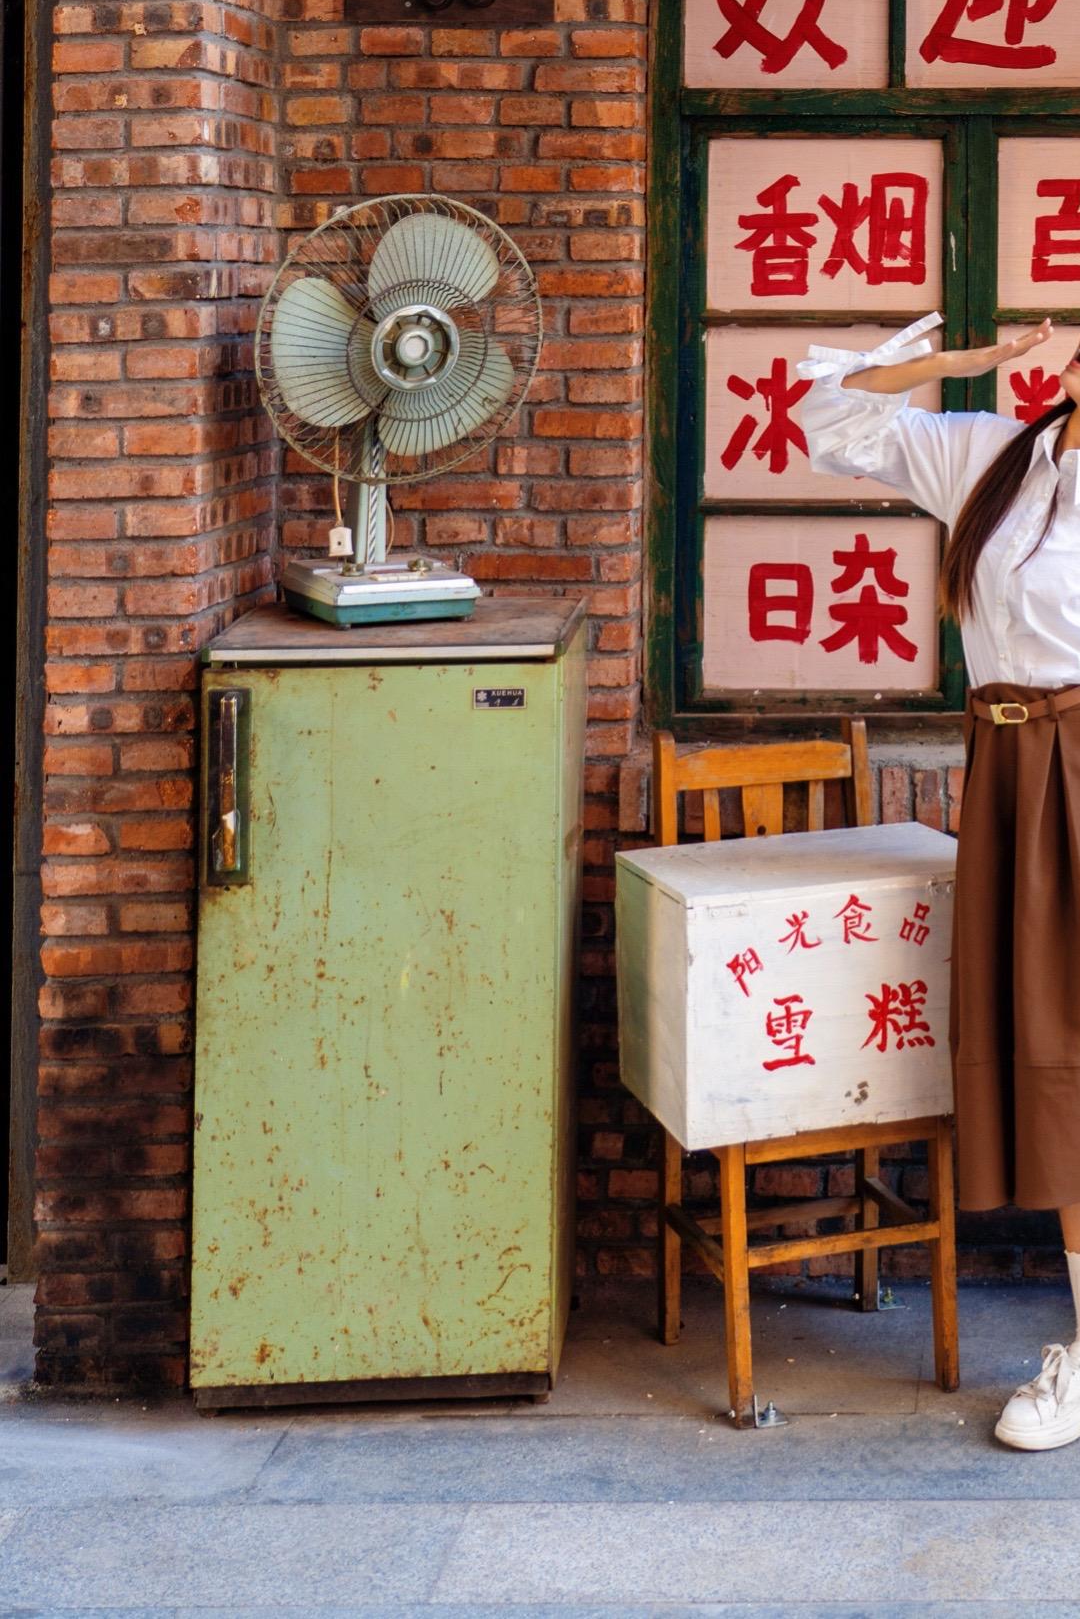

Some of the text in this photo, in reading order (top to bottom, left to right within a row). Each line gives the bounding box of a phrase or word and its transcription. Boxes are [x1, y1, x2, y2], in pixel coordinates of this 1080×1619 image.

[735, 173, 928, 297] 香烟
[748, 533, 919, 664] 日杂
[490, 689, 523, 697] XUEHUA
[726, 893, 931, 998] 阳光食品
[762, 979, 936, 1073] 雪糕
